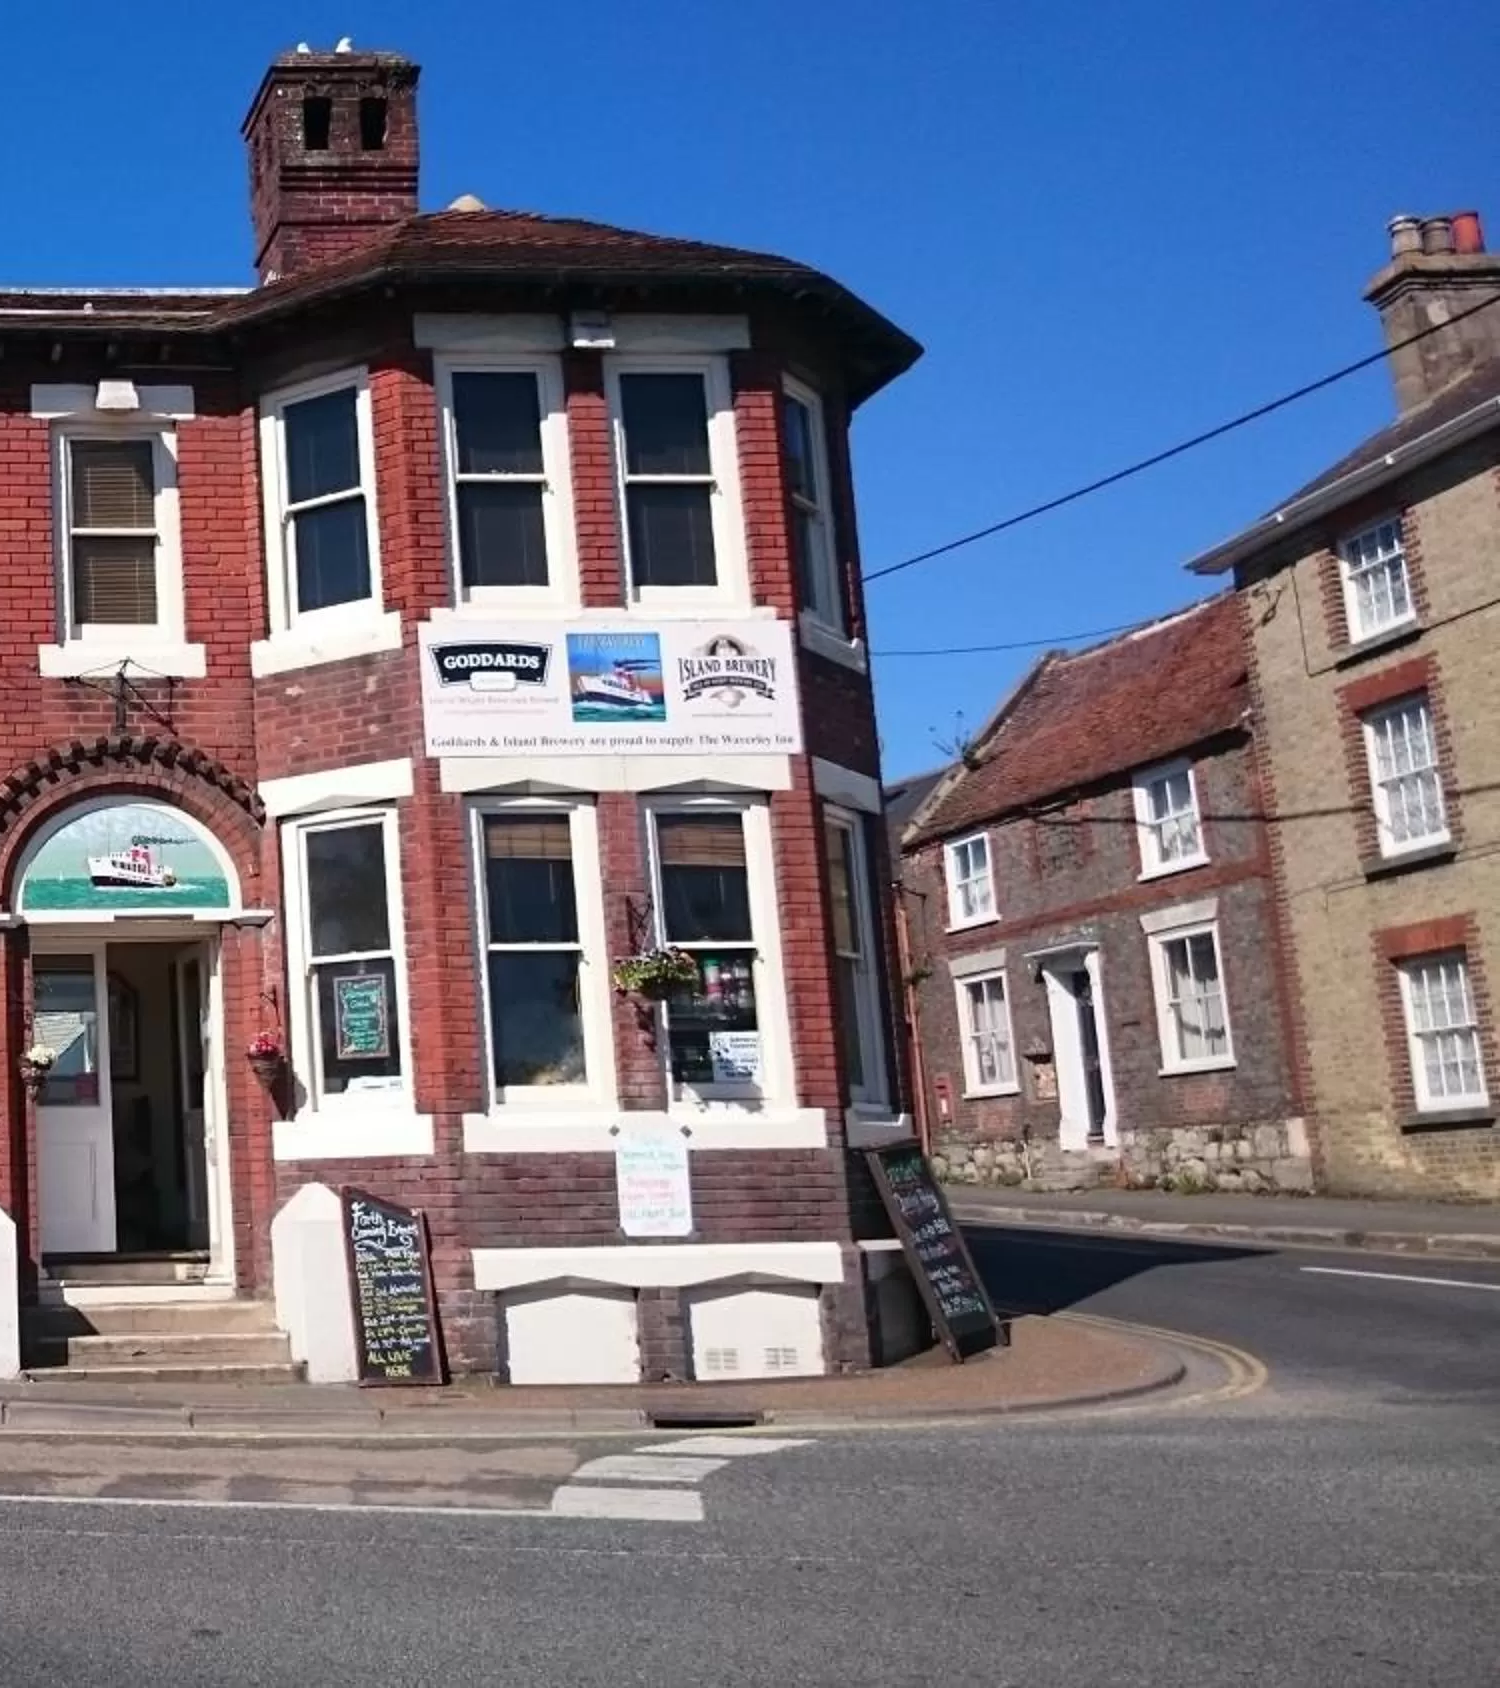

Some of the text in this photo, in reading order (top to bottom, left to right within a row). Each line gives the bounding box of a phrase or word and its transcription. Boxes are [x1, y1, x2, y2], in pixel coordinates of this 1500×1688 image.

[443, 653, 540, 669] GODDARDS
[678, 657, 721, 684] ISLAND
[725, 657, 776, 682] BREWERY
[489, 736, 499, 746] &
[503, 735, 537, 747] Island
[541, 735, 585, 748] Brewery
[645, 736, 657, 745] to
